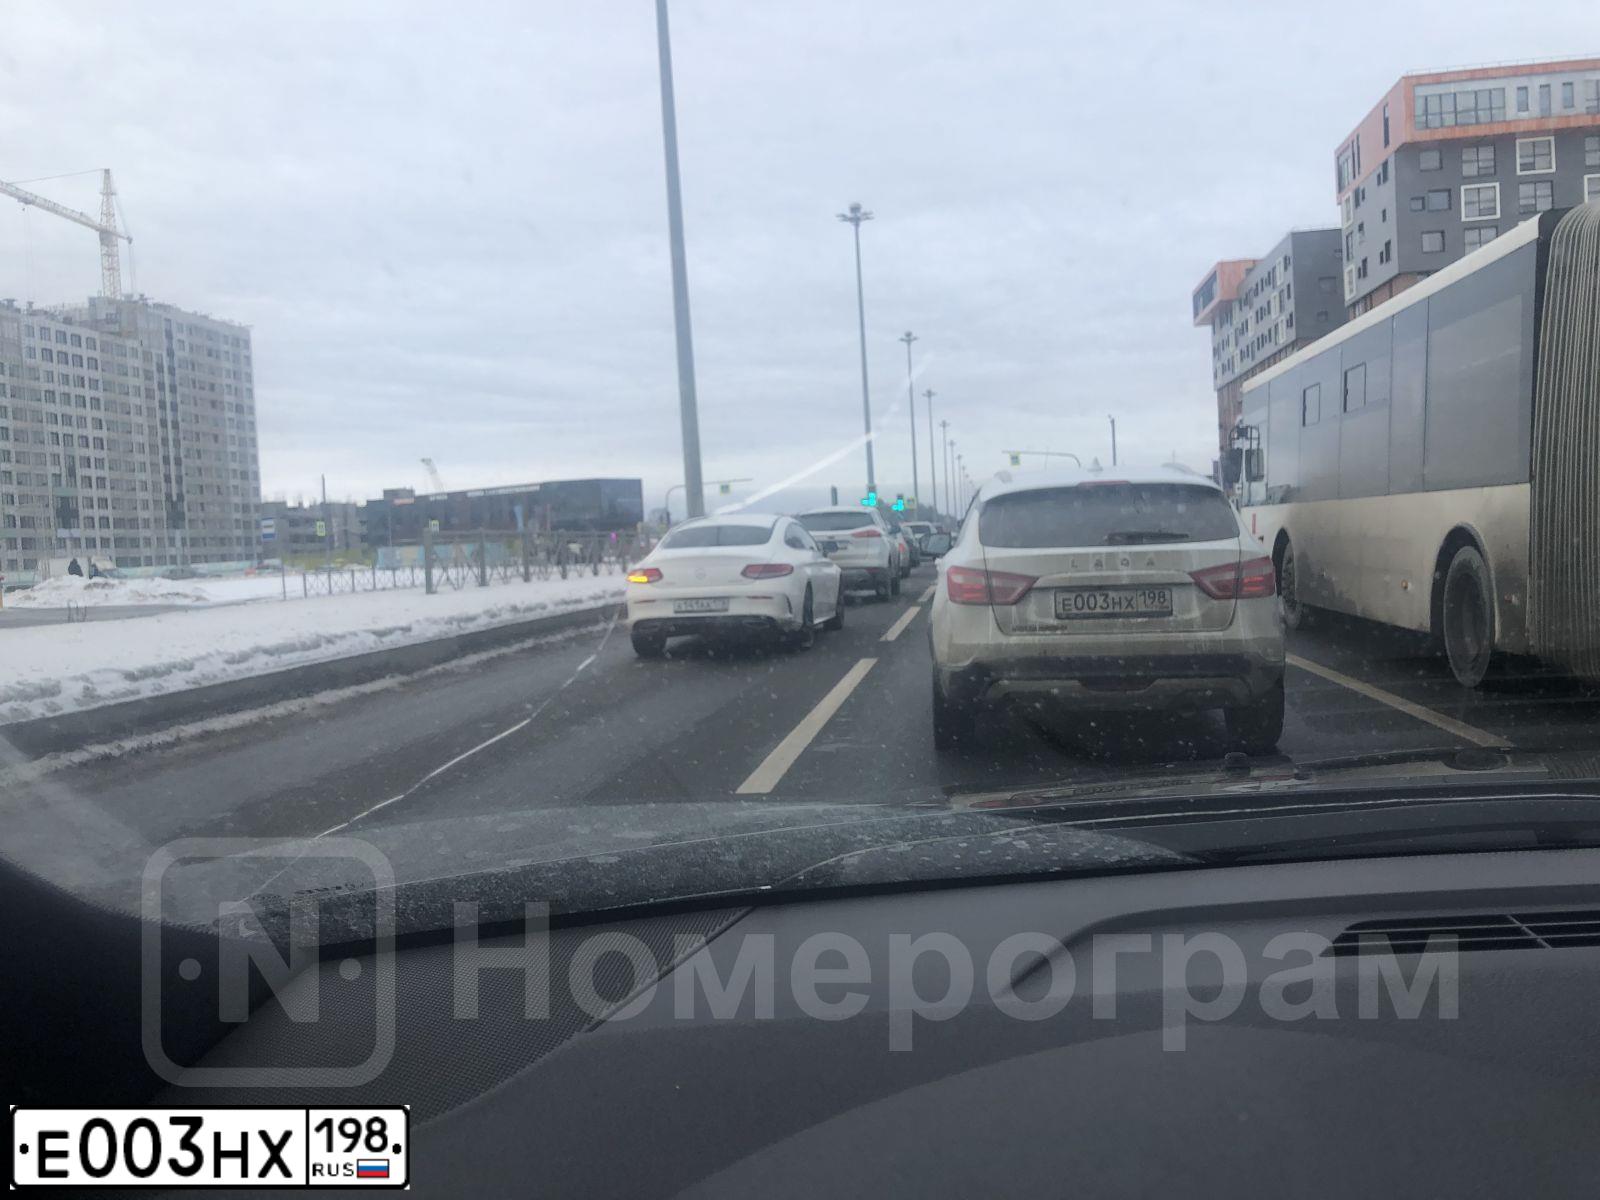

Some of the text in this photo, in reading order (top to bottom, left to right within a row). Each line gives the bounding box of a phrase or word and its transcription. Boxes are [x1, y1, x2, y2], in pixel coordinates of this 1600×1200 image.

[1071, 558, 1155, 568] LADA
[1062, 590, 1166, 612] Е003НХ 198
